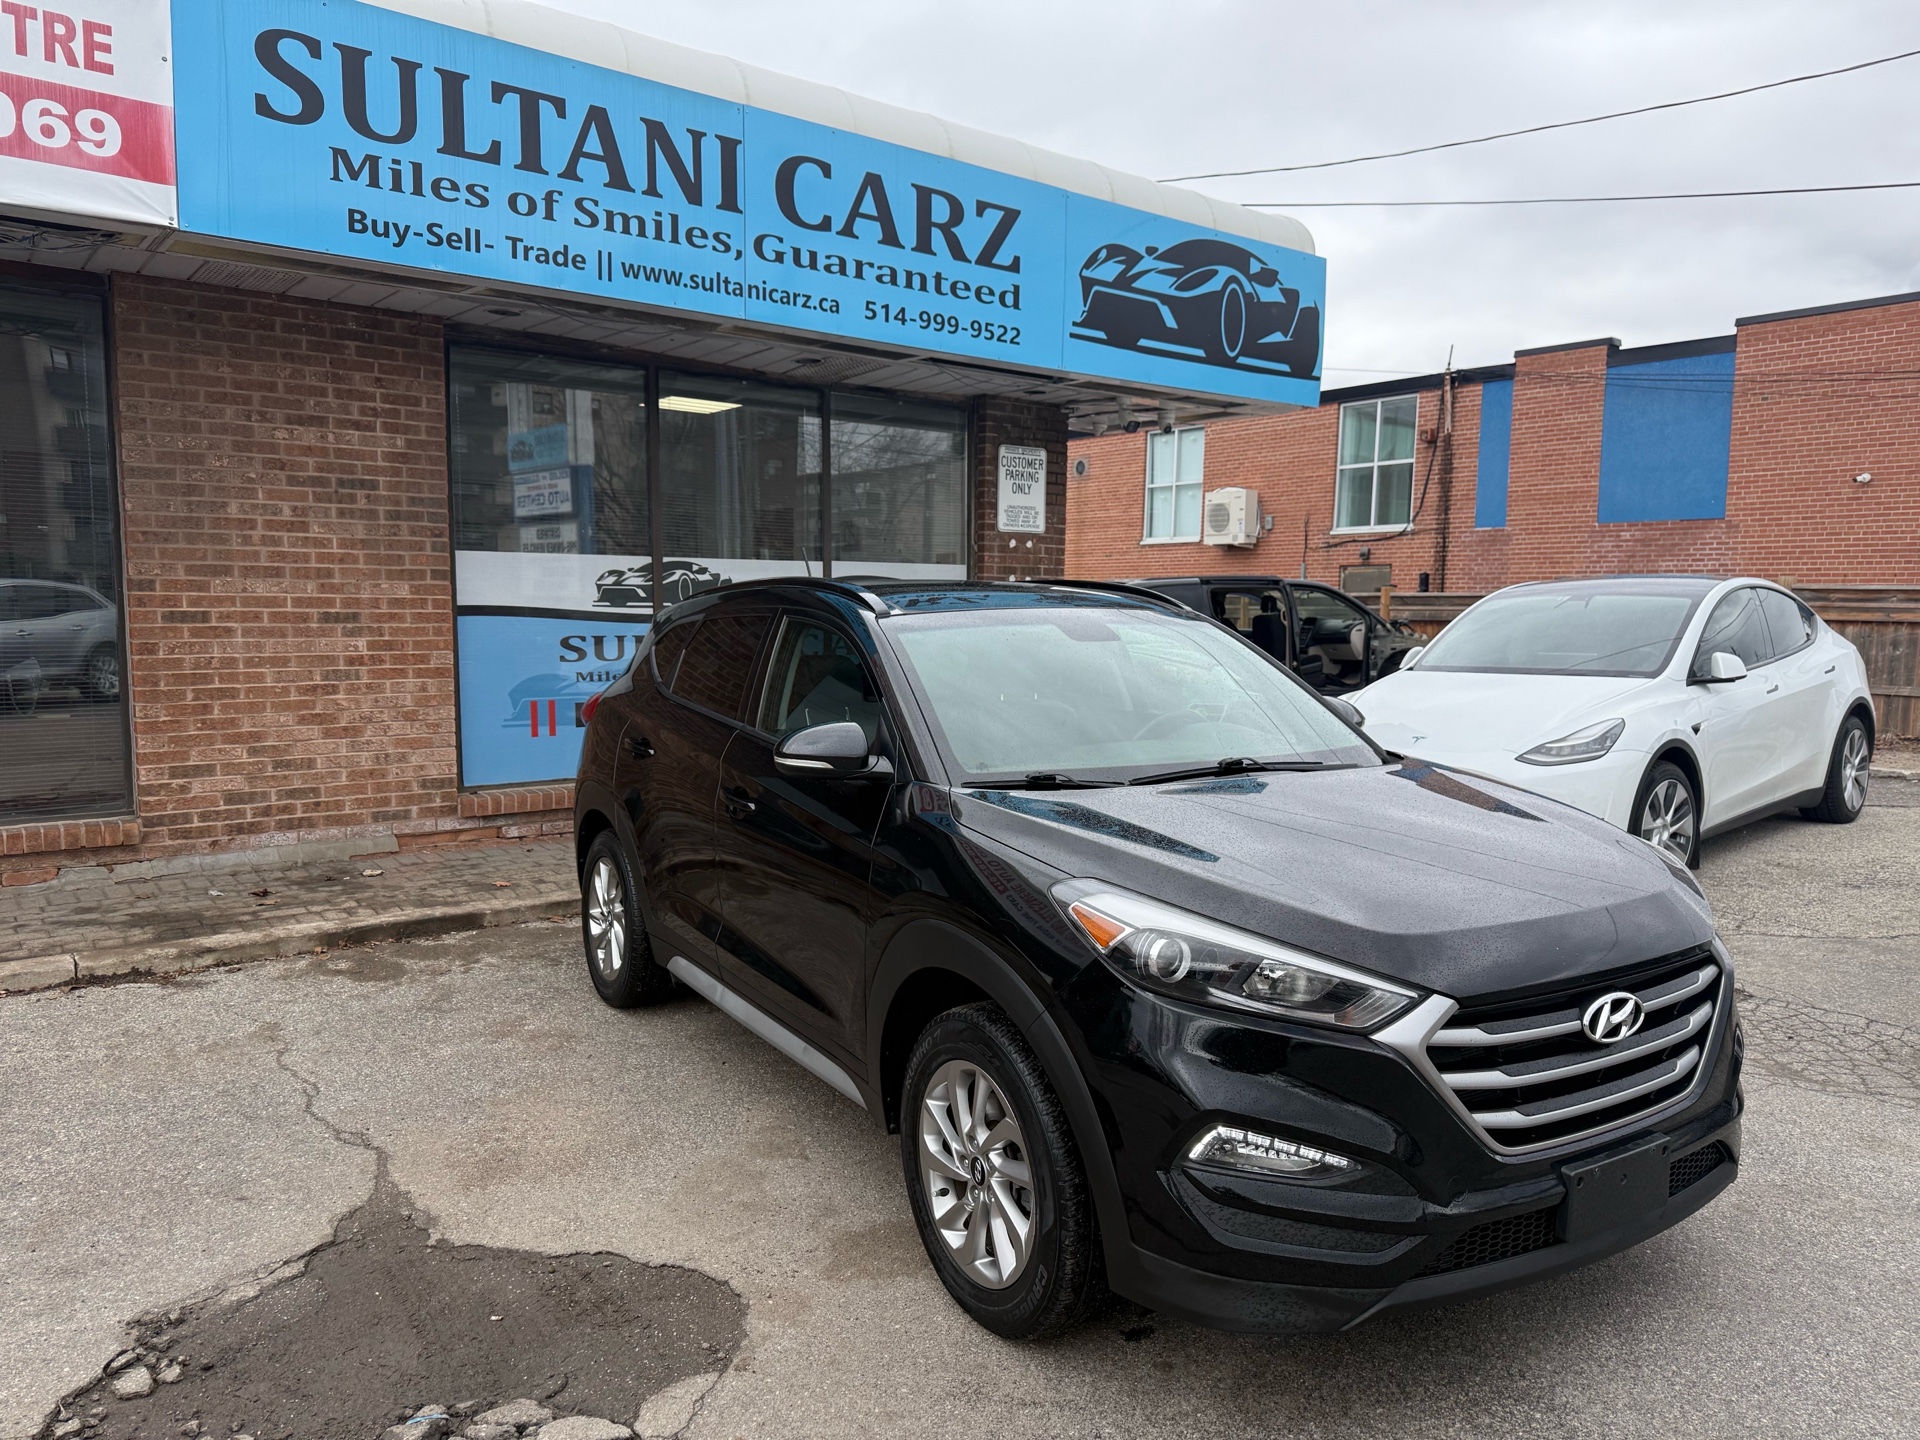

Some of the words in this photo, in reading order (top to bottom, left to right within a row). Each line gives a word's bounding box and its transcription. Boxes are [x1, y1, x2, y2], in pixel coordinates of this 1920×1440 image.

[0, 0, 114, 76] TRE
[254, 28, 743, 214] SULTANI
[774, 155, 1021, 275] CARZ
[328, 146, 490, 208] Miles
[507, 190, 563, 222] of
[753, 233, 1022, 311] Guaranteed
[505, 235, 587, 271] Trade
[621, 261, 840, 314] www.sultanicarz.ca
[864, 300, 1021, 345] 514-999-9522
[1001, 455, 1044, 471] CUSTOMER
[1005, 469, 1039, 483] PARKING
[1011, 482, 1032, 495] ONLY
